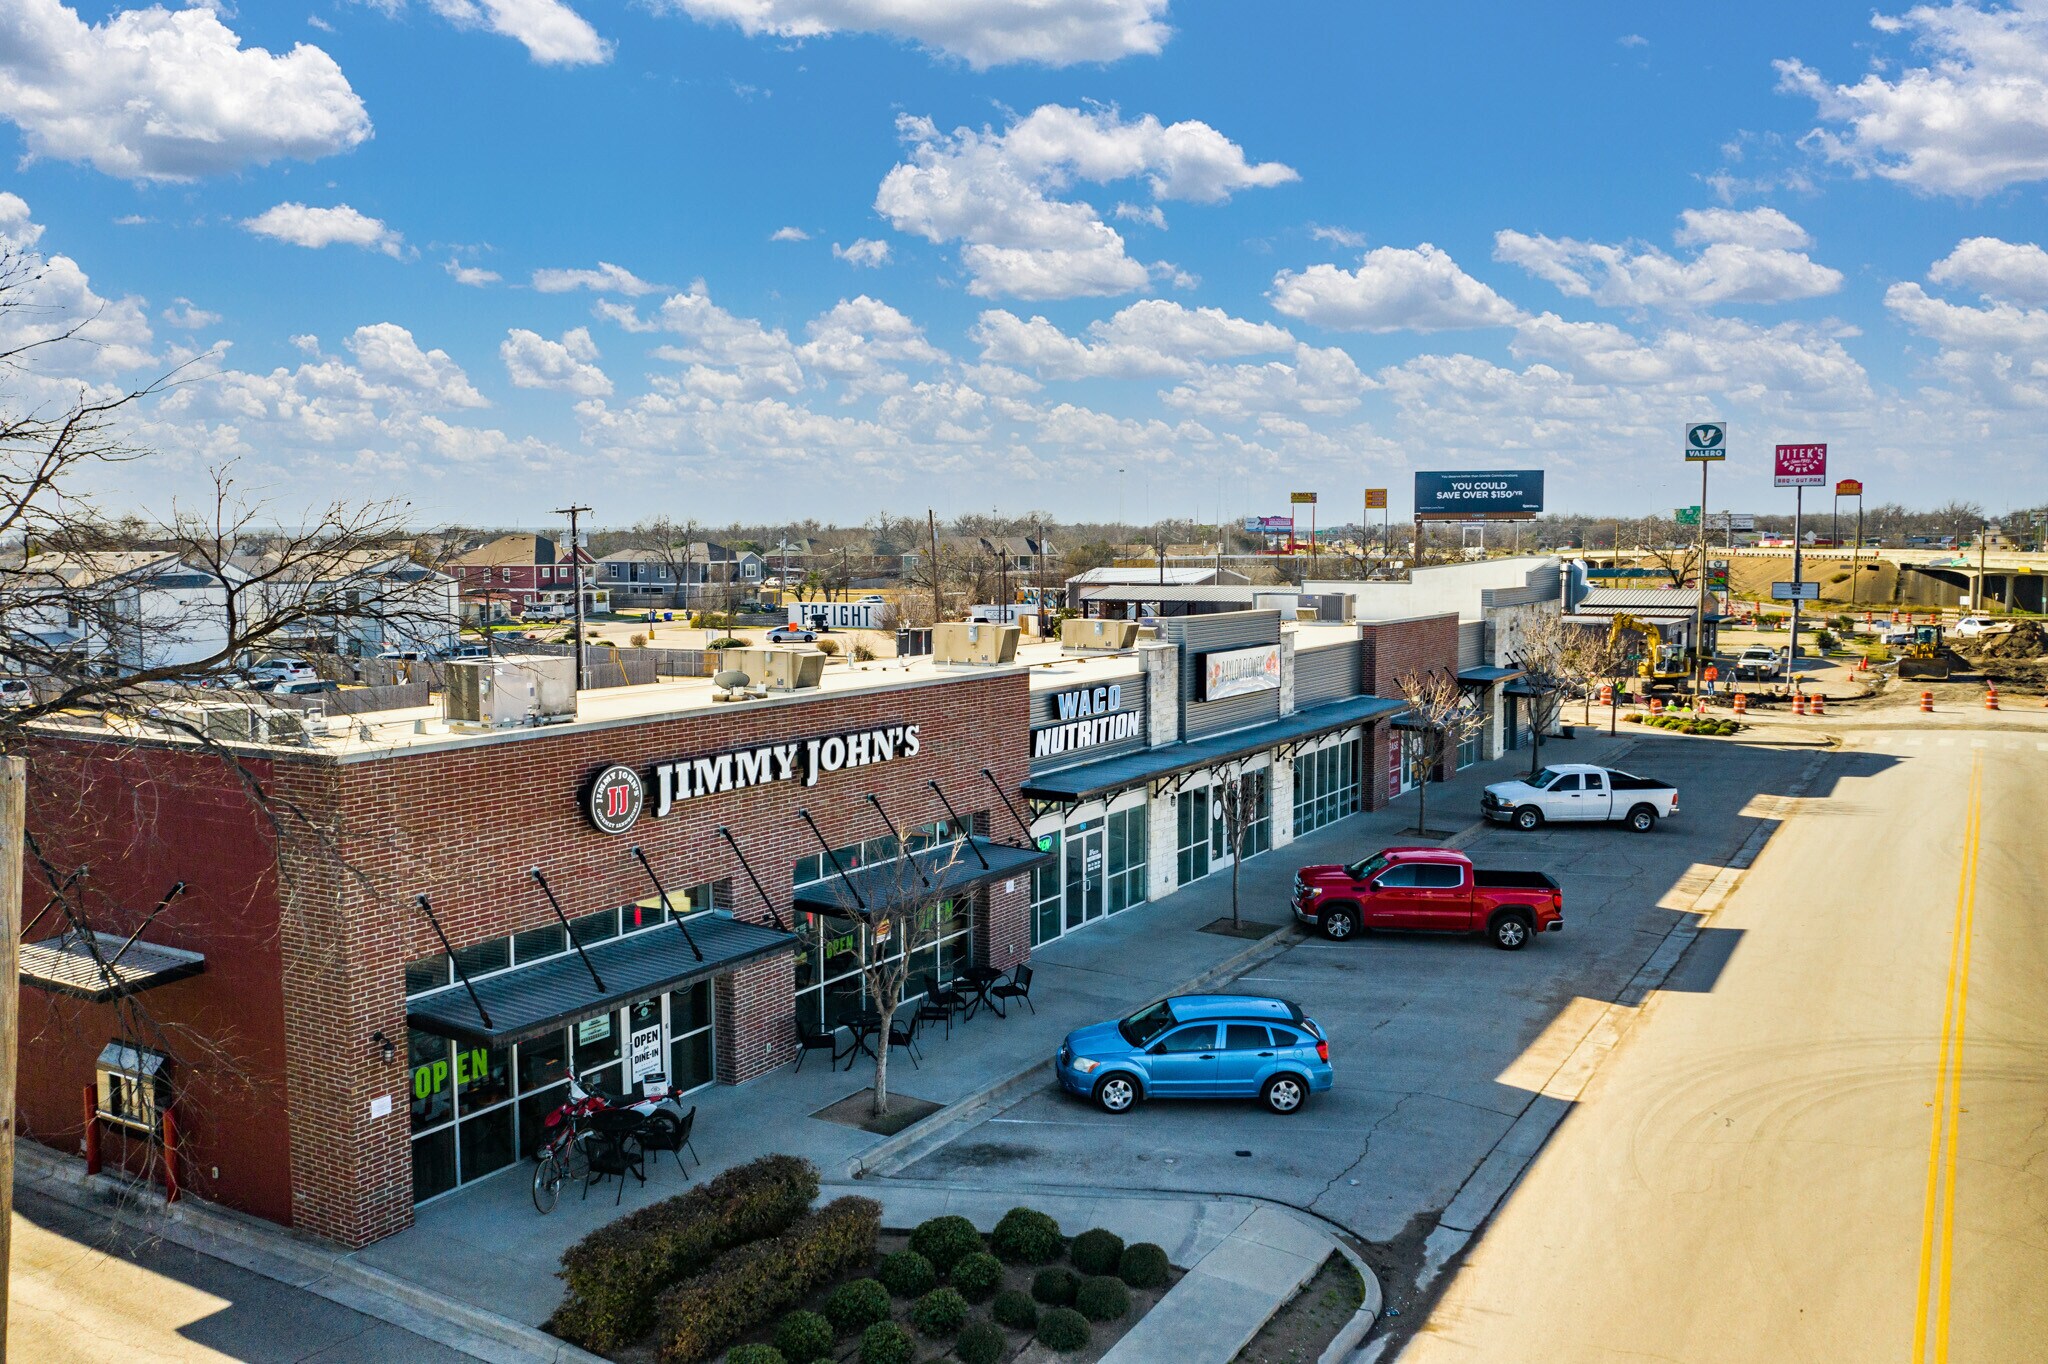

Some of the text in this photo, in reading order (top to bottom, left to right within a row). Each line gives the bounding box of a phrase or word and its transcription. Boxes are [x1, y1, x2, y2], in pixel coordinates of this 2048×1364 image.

[1779, 447, 1823, 460] VITEK'S
[1782, 460, 1819, 473] MARKET
[1452, 482, 1507, 490] YOU COULD
[1463, 491, 1488, 499] OVER
[1057, 685, 1121, 721] WACO
[1035, 711, 1140, 758] NUTRITION
[656, 725, 920, 818] JIMMY JOHN'S
[596, 770, 640, 803] JIMMY JOHN'S
[607, 784, 630, 817] JJ
[826, 935, 853, 959] OPEN
[634, 1029, 659, 1048] OPEN
[634, 1048, 659, 1064] DINE-IN
[415, 1048, 488, 1099] OPEN
